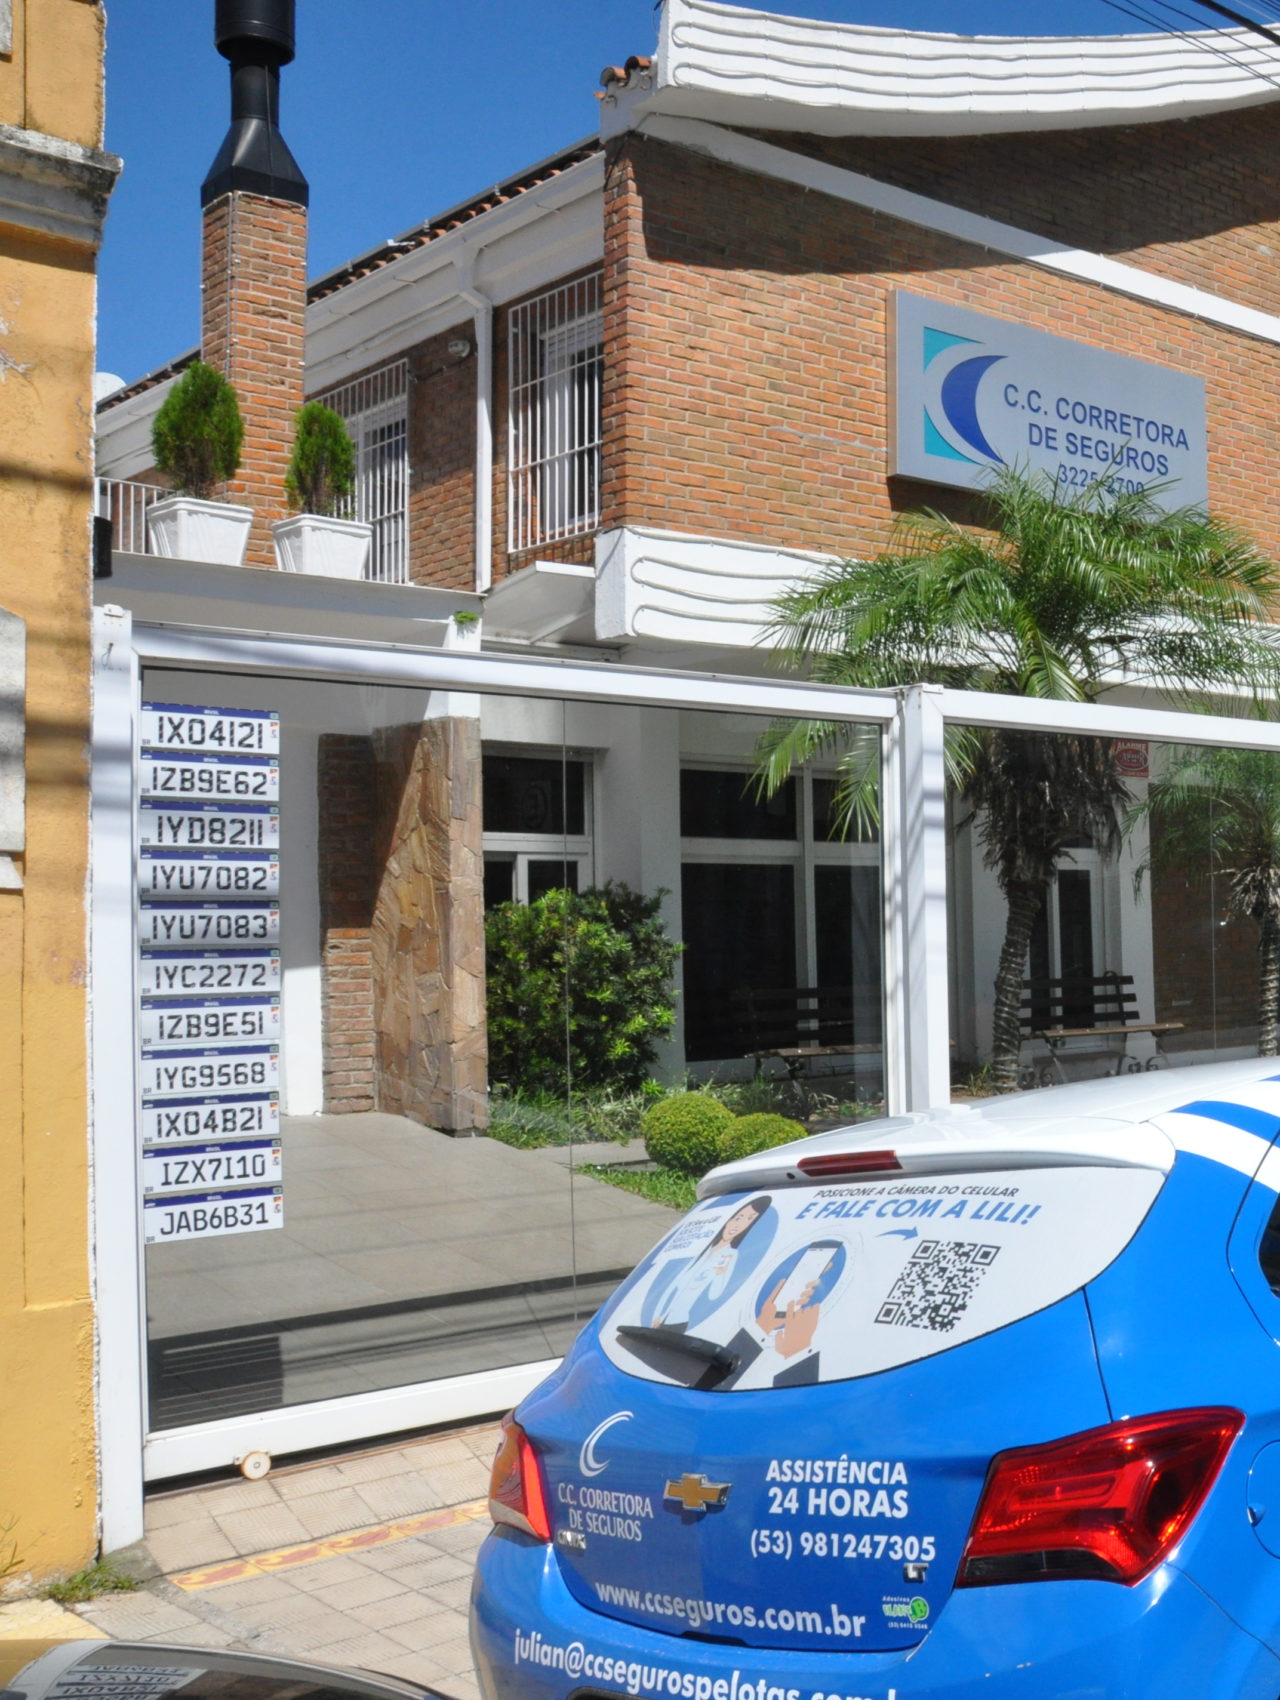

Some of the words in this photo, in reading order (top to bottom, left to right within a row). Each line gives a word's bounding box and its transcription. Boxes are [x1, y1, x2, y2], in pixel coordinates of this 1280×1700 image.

[1003, 383, 1048, 416] C.C.
[1055, 397, 1190, 451] CORRETORA
[1028, 422, 1058, 451] DE
[1065, 432, 1170, 476] SEGUROS
[152, 766, 268, 796] IZB9E62
[152, 865, 268, 891] IYU7082
[152, 915, 268, 940] IYU7083
[155, 963, 267, 990] IYC2272
[156, 1061, 266, 1091] IYG9568
[160, 1154, 267, 1187] IZX7I10
[813, 1187, 876, 1198] POSICIONE
[876, 1187, 887, 1195] A
[887, 1183, 936, 1195] CÂMERA
[937, 1186, 959, 1195] DO
[961, 1186, 1020, 1197] CELULAR
[160, 1202, 270, 1236] JAB6B31
[795, 1202, 818, 1219] E
[814, 1200, 875, 1219] FALE
[875, 1199, 938, 1218] COM
[941, 1199, 969, 1218] A
[969, 1201, 1042, 1225] LILI!
[765, 1454, 909, 1485] ASSISTÊNCIA
[558, 1483, 577, 1505] C.C.
[580, 1486, 654, 1519] CORRETORA
[768, 1486, 799, 1514] 24
[808, 1488, 909, 1519] HORAS
[569, 1508, 583, 1531] DE
[585, 1511, 642, 1542] SEGUROS
[751, 1528, 793, 1560] (53)
[800, 1531, 937, 1561] 981247305
[595, 1581, 867, 1638] www.ccseguros.com.br
[513, 1627, 897, 1700] julian@ccsegurospelota
